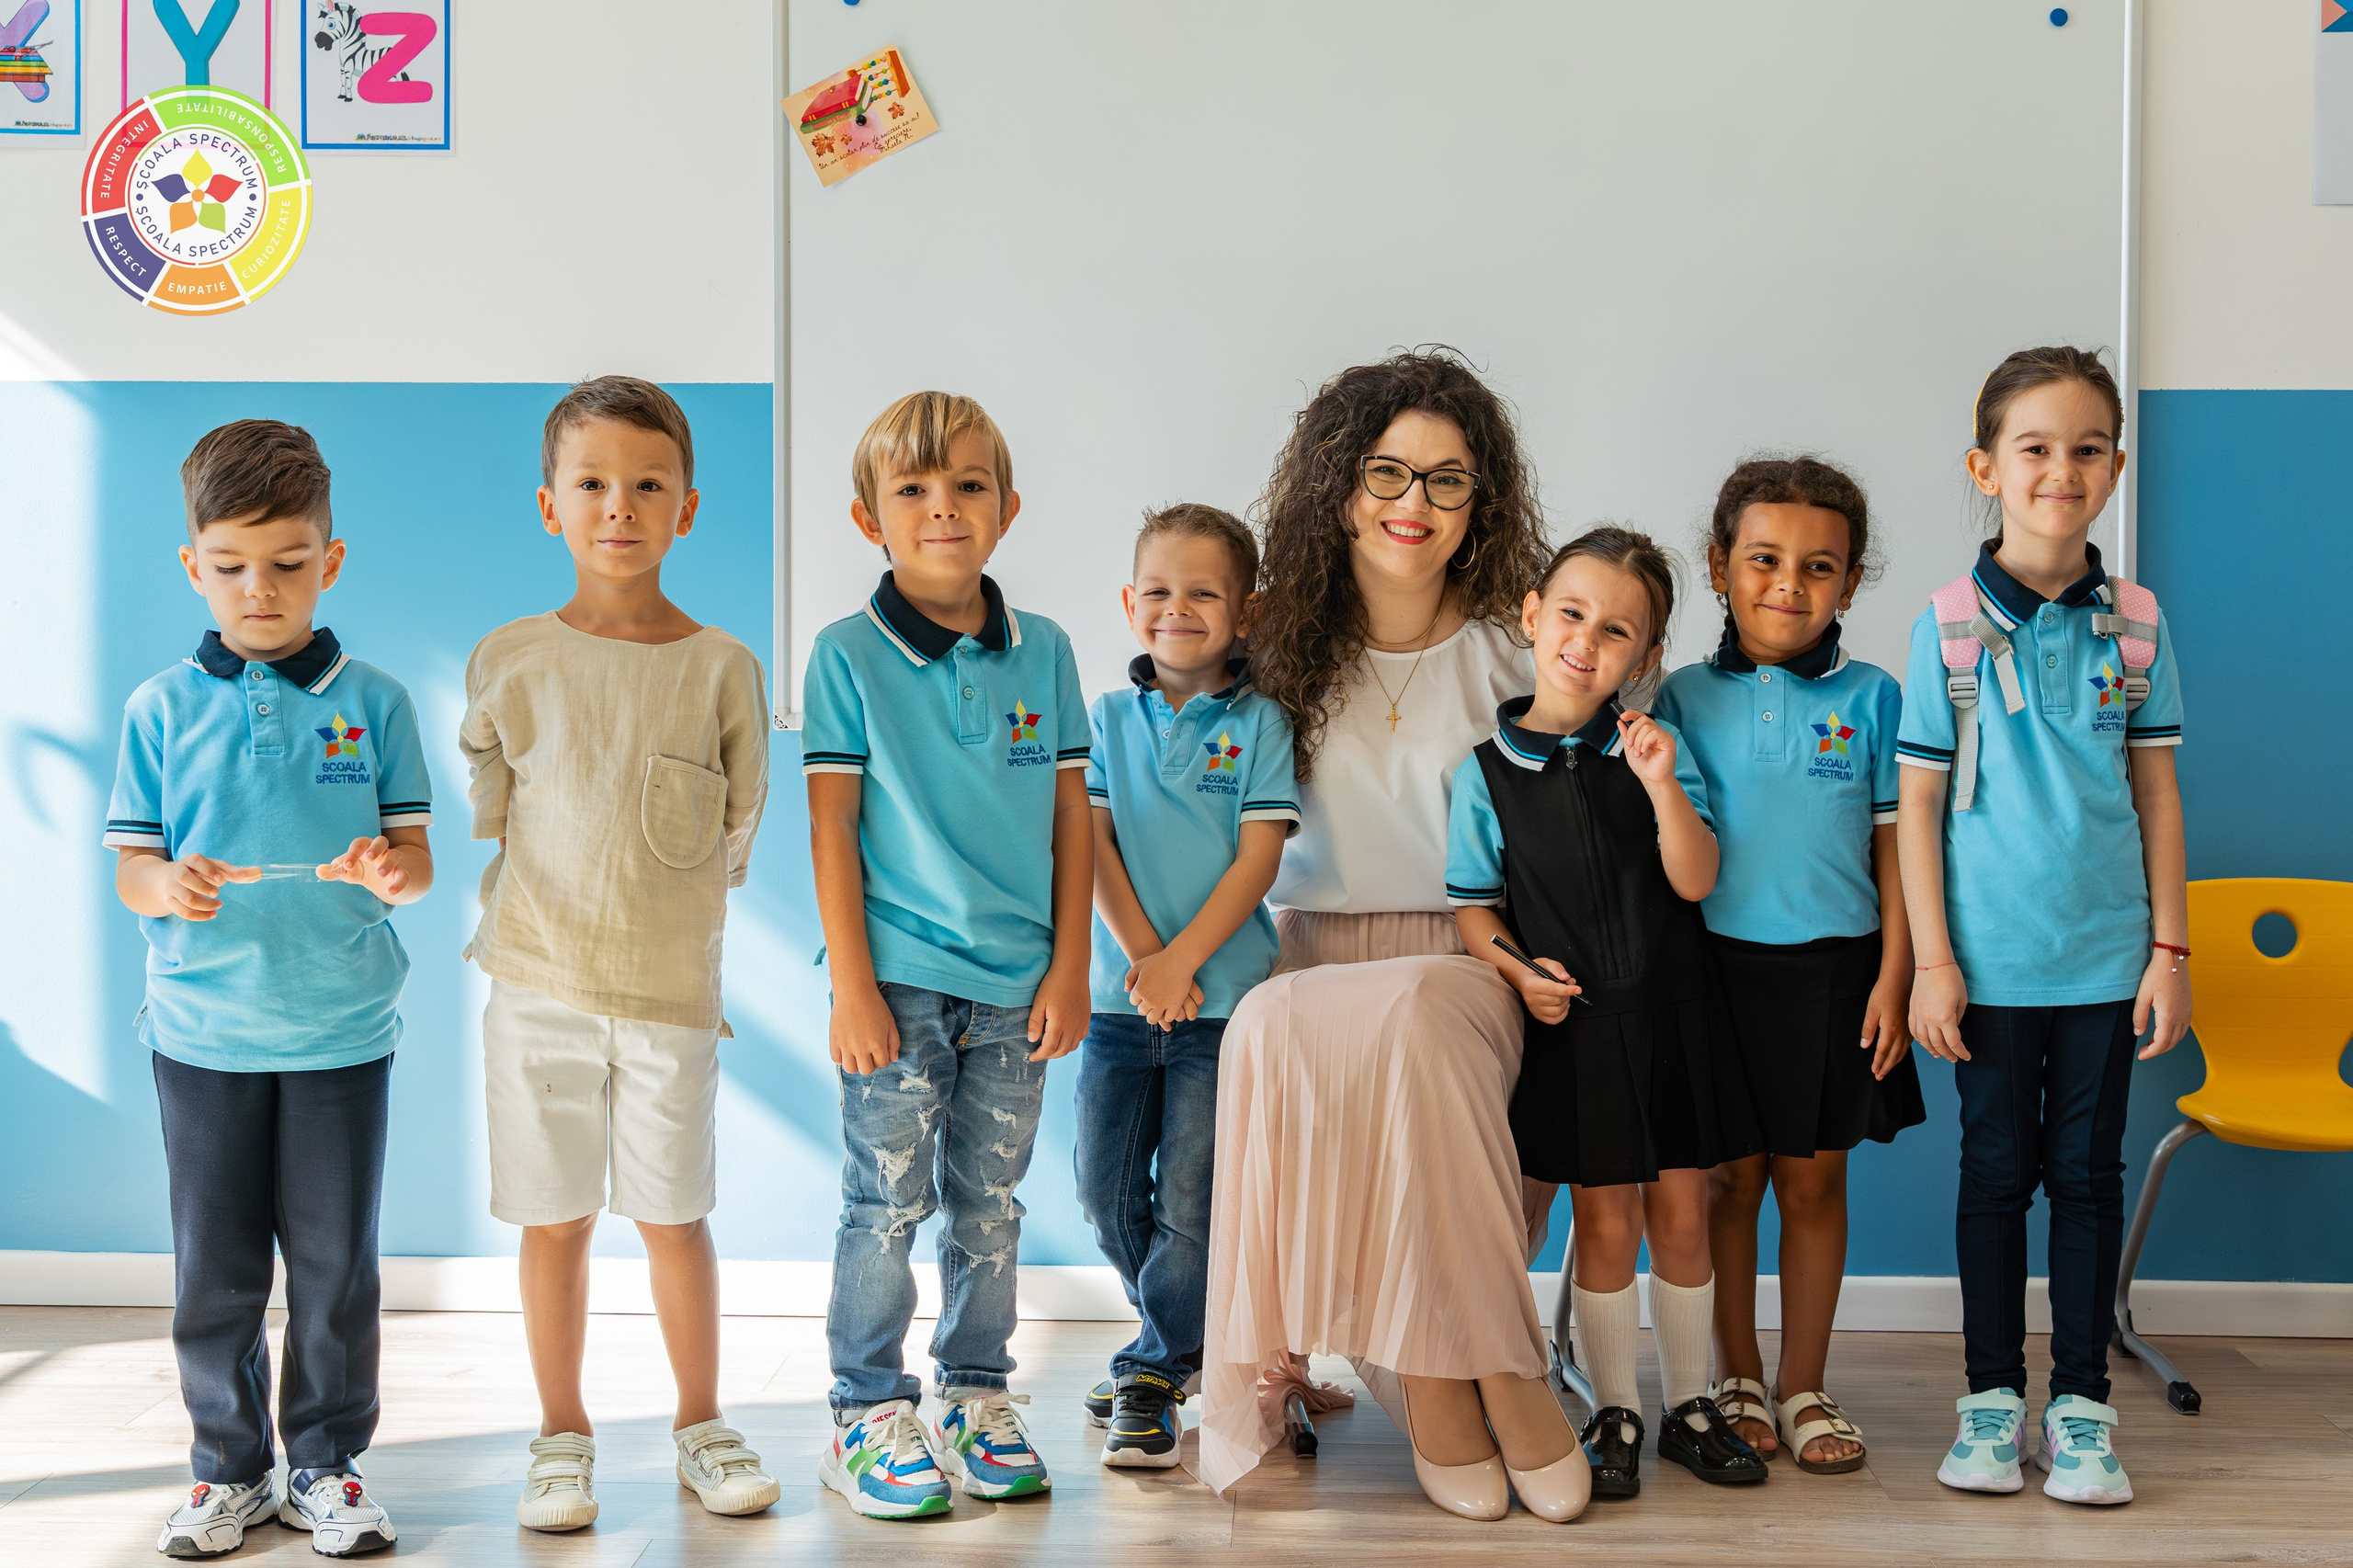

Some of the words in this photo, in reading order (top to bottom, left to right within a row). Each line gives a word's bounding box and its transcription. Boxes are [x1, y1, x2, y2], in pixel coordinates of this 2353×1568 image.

[153, 0, 240, 104] Y
[358, 13, 437, 103] Z
[1010, 744, 1046, 756] SCOALA
[322, 762, 367, 772] SCOALA
[1006, 755, 1051, 767] SPECTRUM
[1814, 756, 1852, 770] SCOALA
[315, 774, 370, 784] SPECTRUM
[1202, 774, 1238, 786] SCOALA
[1807, 767, 1854, 781] SPECTRUM
[1196, 784, 1239, 796] SPECTRUM
